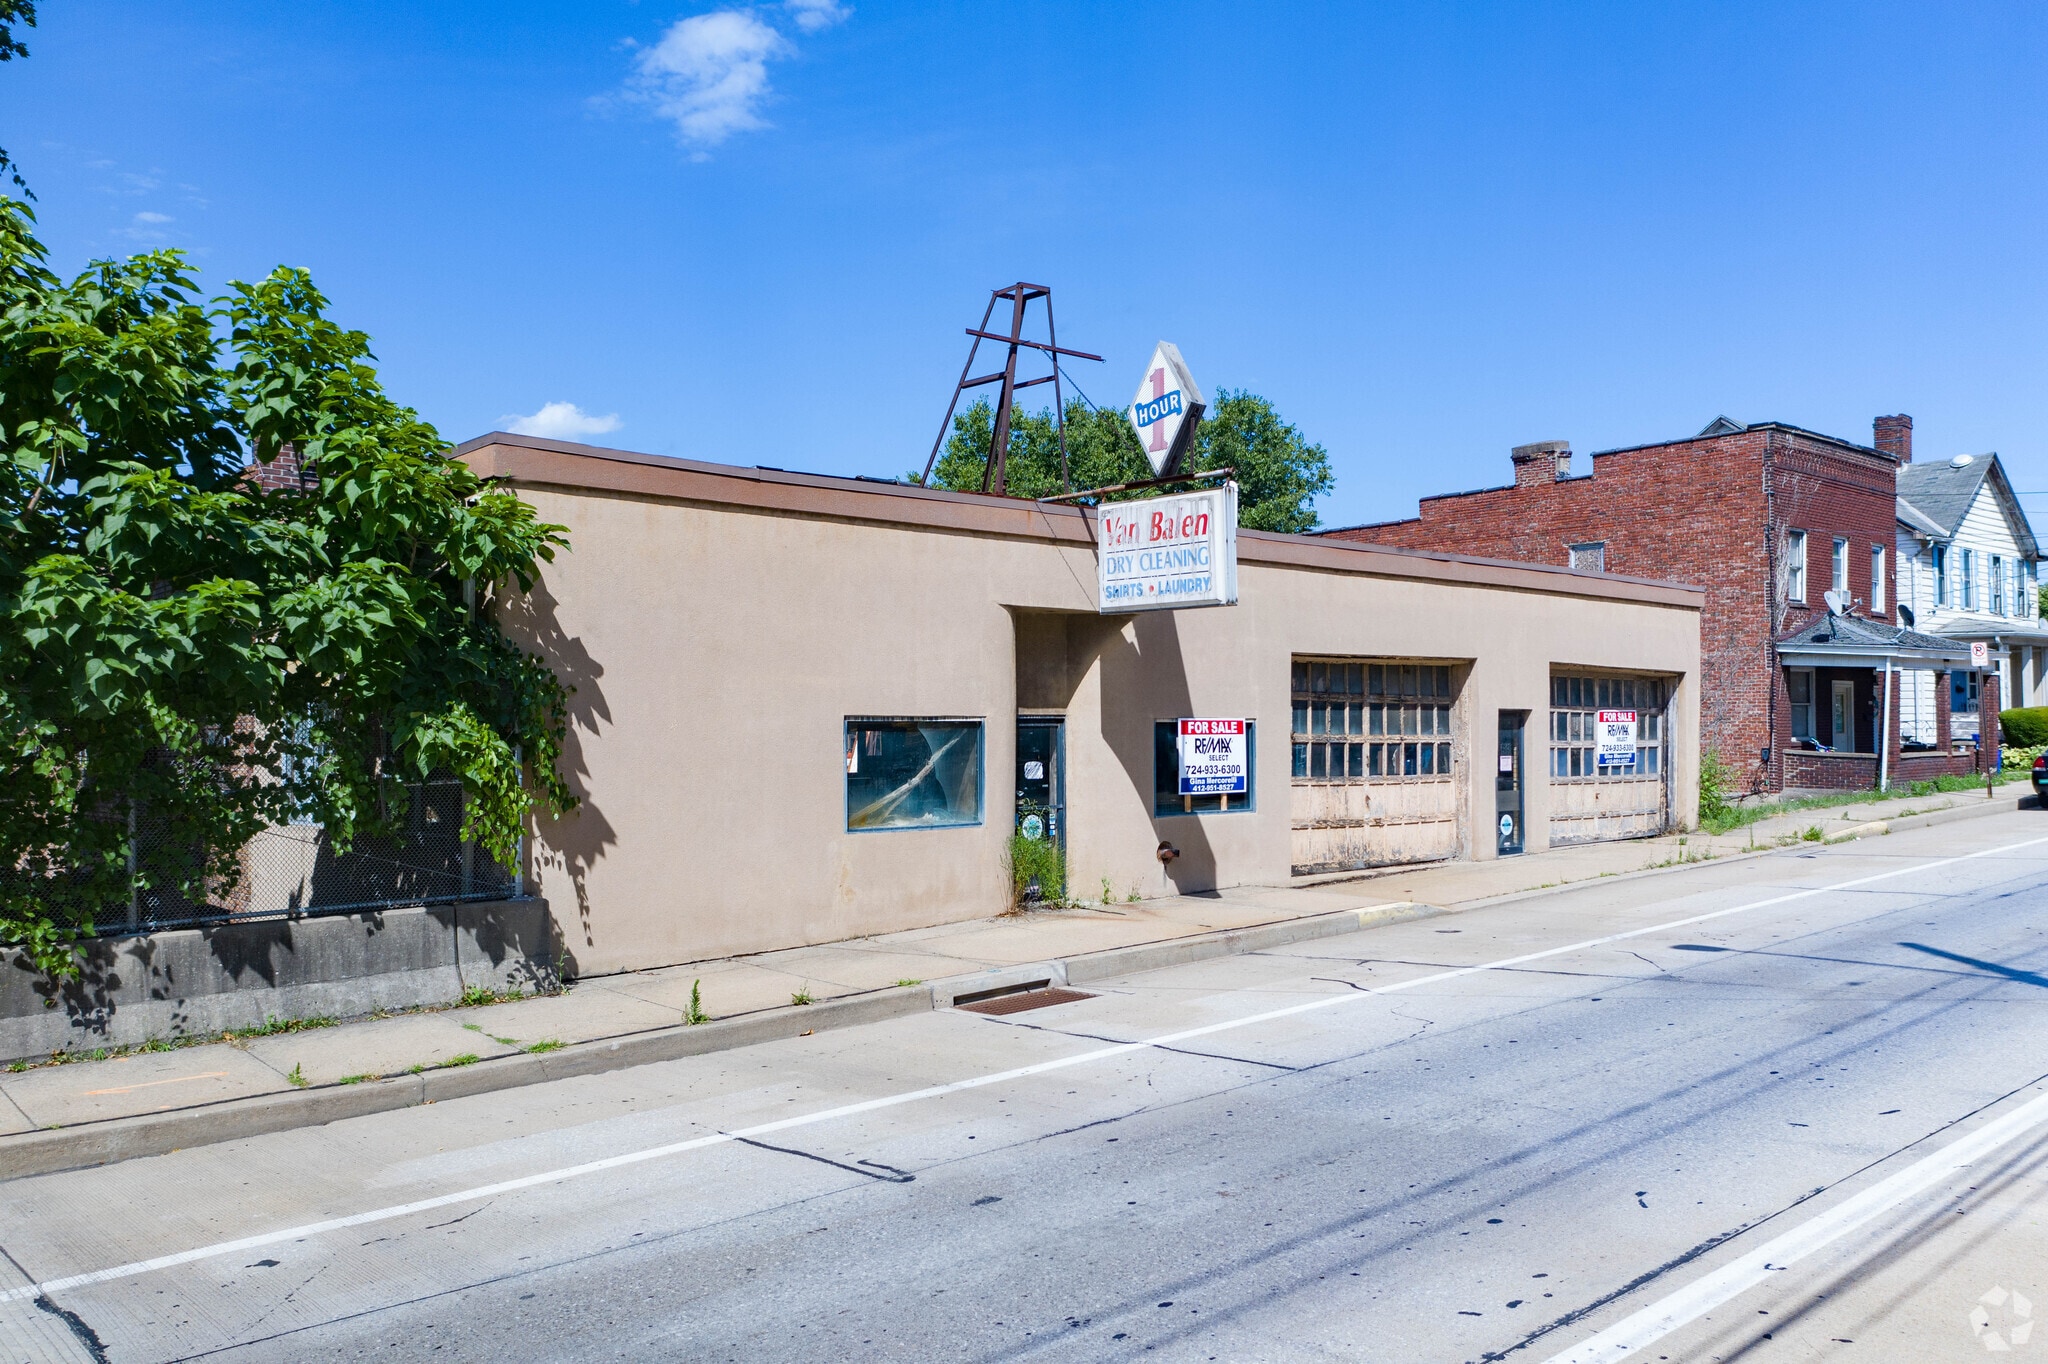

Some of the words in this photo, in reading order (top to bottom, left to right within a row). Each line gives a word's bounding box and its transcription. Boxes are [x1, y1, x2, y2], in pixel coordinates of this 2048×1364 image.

[1139, 394, 1179, 425] HOUR
[1149, 367, 1168, 453] 1
[1105, 516, 1140, 547] Van
[1149, 507, 1209, 542] Balen
[1106, 553, 1134, 575] DRY
[1139, 546, 1209, 572] CLEANING
[1105, 582, 1144, 599] SHIRTS
[1157, 576, 1211, 596] LAUNDRY
[1604, 712, 1616, 722] FOR
[1618, 712, 1632, 722] SALE
[1187, 721, 1209, 734] FOR
[1211, 721, 1238, 734] SALE
[1608, 724, 1630, 736] RE/MAX
[1194, 737, 1232, 754] RE/MAX
[1185, 765, 1240, 774] 724-933-6300
